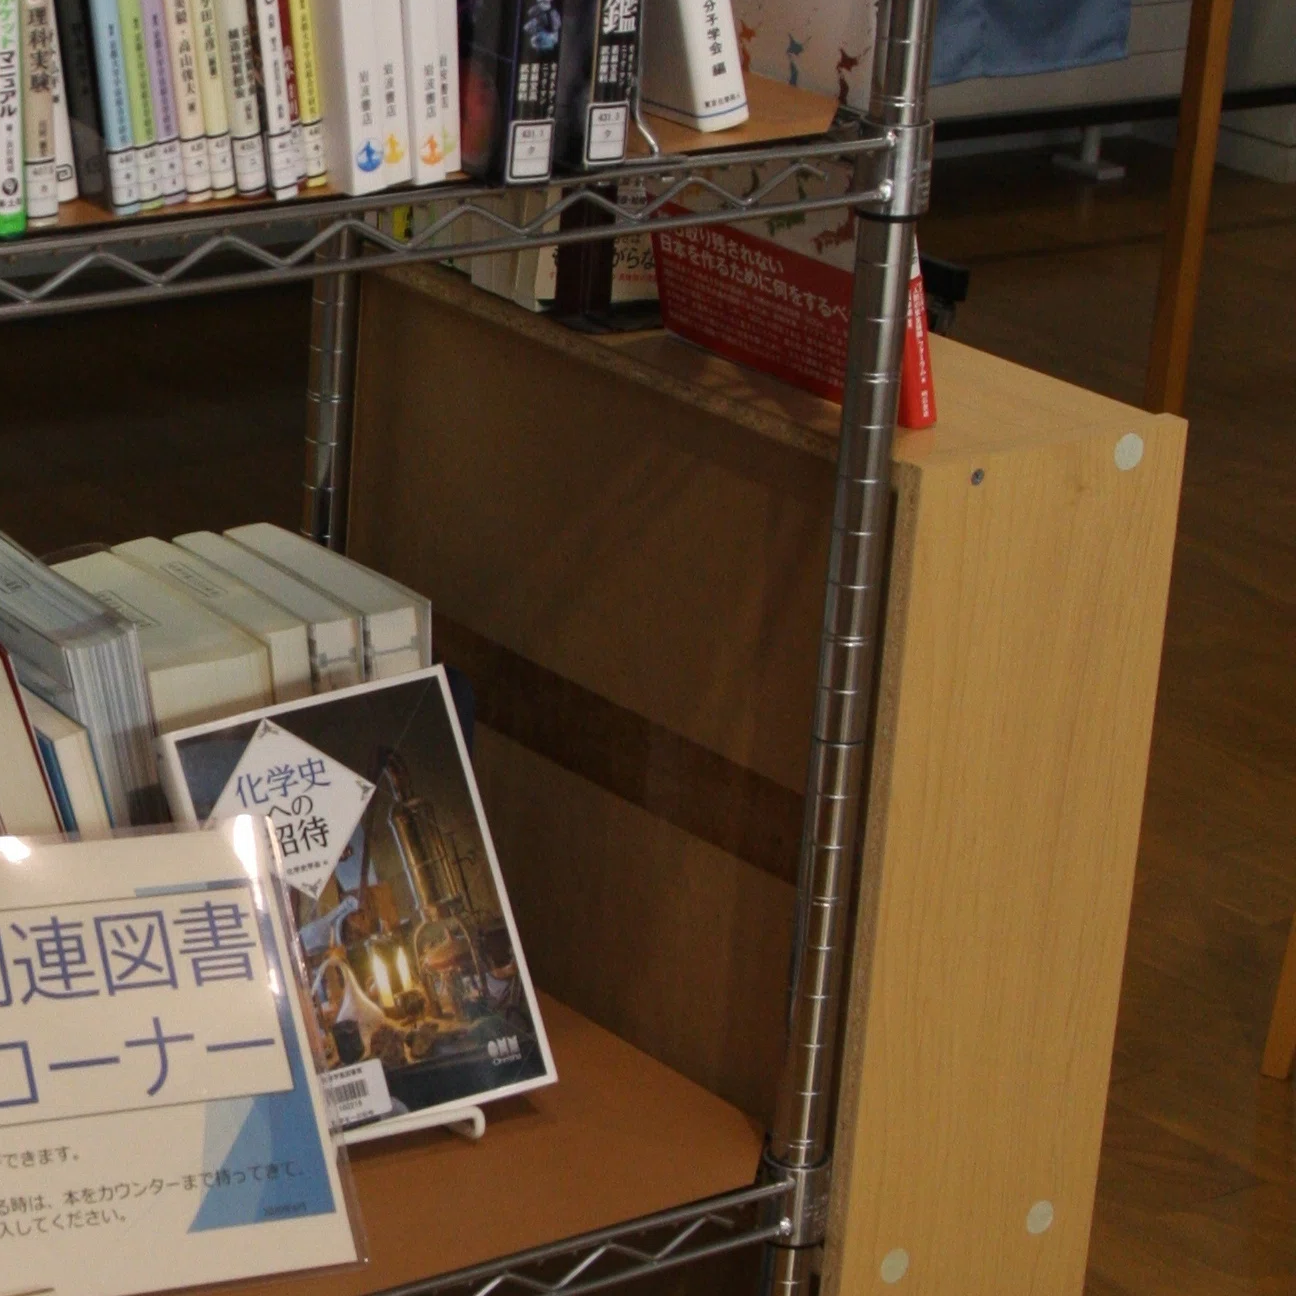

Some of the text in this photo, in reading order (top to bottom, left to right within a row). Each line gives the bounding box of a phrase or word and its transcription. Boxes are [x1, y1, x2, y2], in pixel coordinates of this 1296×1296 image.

[27, 7, 51, 94] 理科実験
[712, 62, 728, 77] 編
[358, 70, 373, 126] 岩波書店
[383, 61, 397, 118] 岩波書店
[423, 64, 437, 119] 岩波書店
[235, 757, 332, 810] 化学史
[268, 792, 314, 821] への
